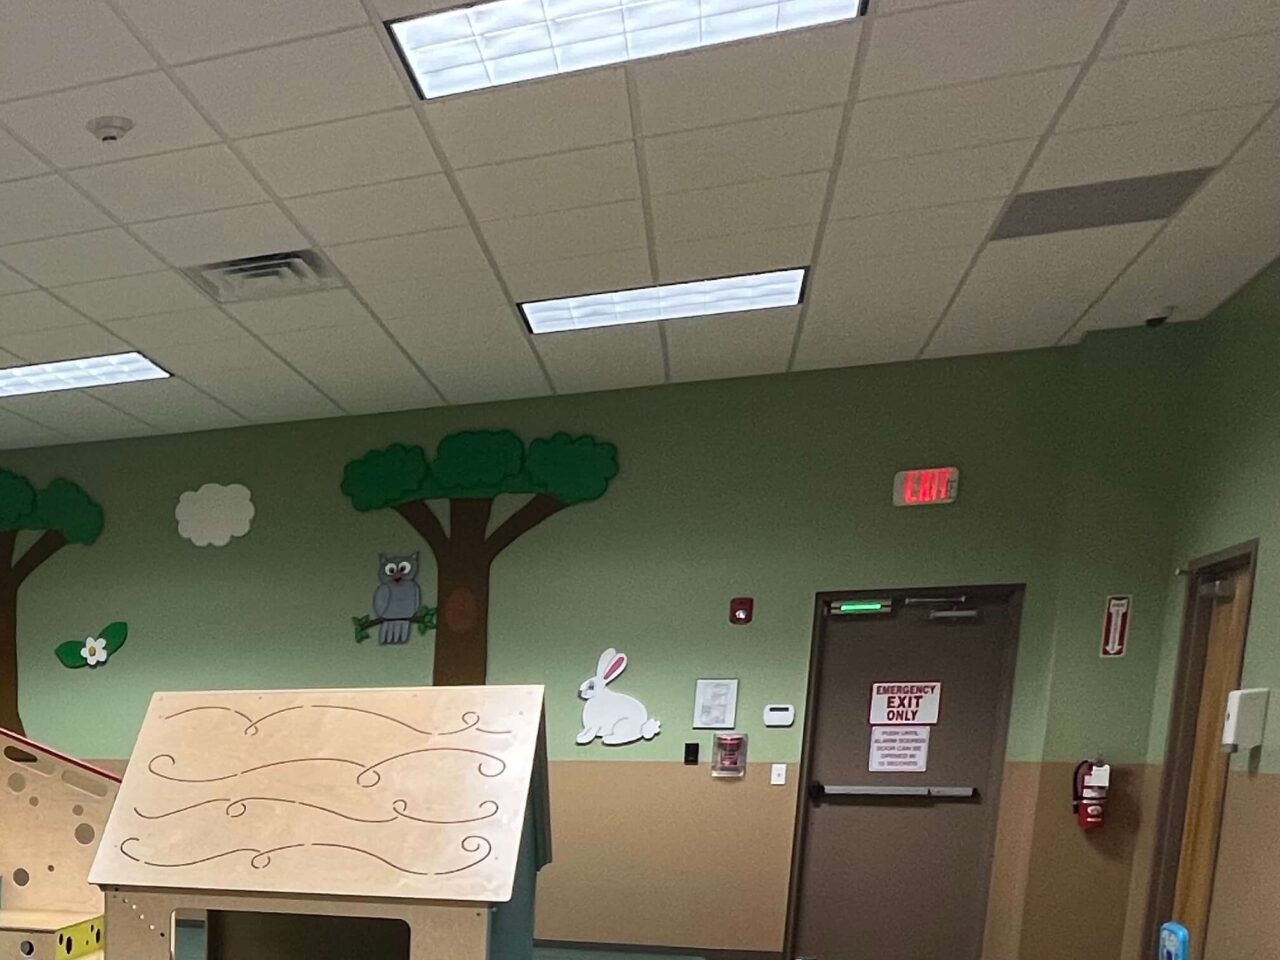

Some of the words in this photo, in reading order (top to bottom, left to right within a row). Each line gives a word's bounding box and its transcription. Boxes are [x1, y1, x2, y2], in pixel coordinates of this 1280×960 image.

[904, 470, 950, 503] EXIT
[876, 685, 936, 695] EMERGENCY
[886, 695, 924, 709] EXIT
[886, 710, 918, 721] ONLY
